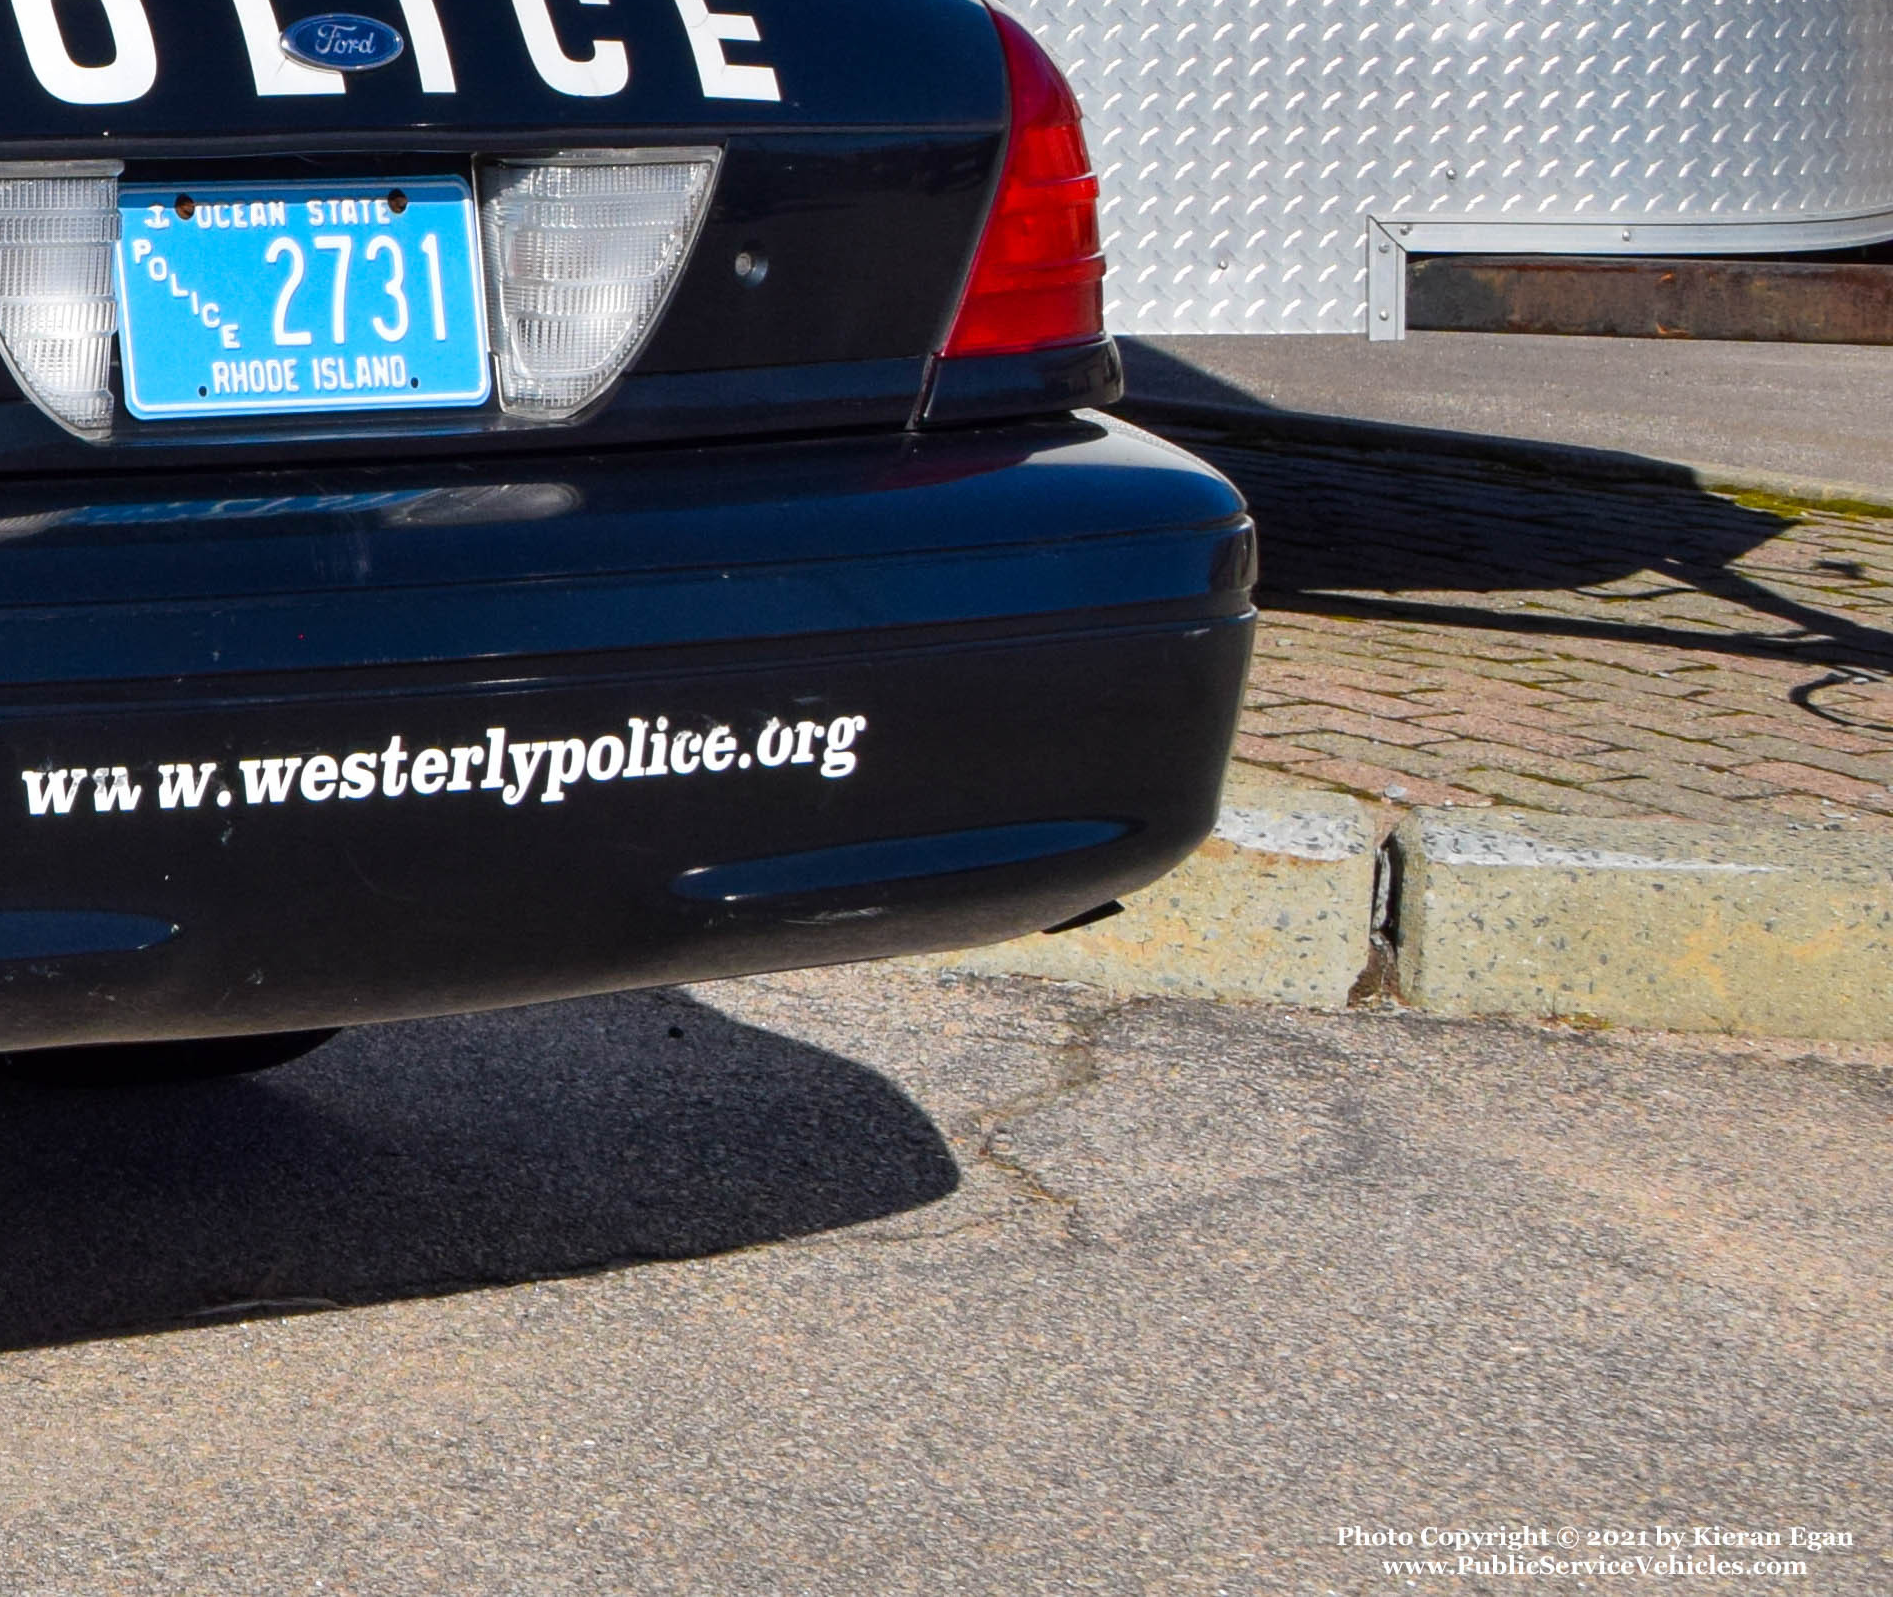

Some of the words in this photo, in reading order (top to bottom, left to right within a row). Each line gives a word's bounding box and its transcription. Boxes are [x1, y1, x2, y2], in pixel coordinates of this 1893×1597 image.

[315, 23, 376, 54] Ford
[196, 201, 286, 229] OCEAN
[306, 199, 391, 227] STATE
[133, 238, 241, 350] POLICE
[265, 233, 446, 346] 2731
[213, 358, 300, 394] RHODE
[312, 355, 406, 390] ISLAND
[21, 714, 867, 815] www.westerlypolice.org
